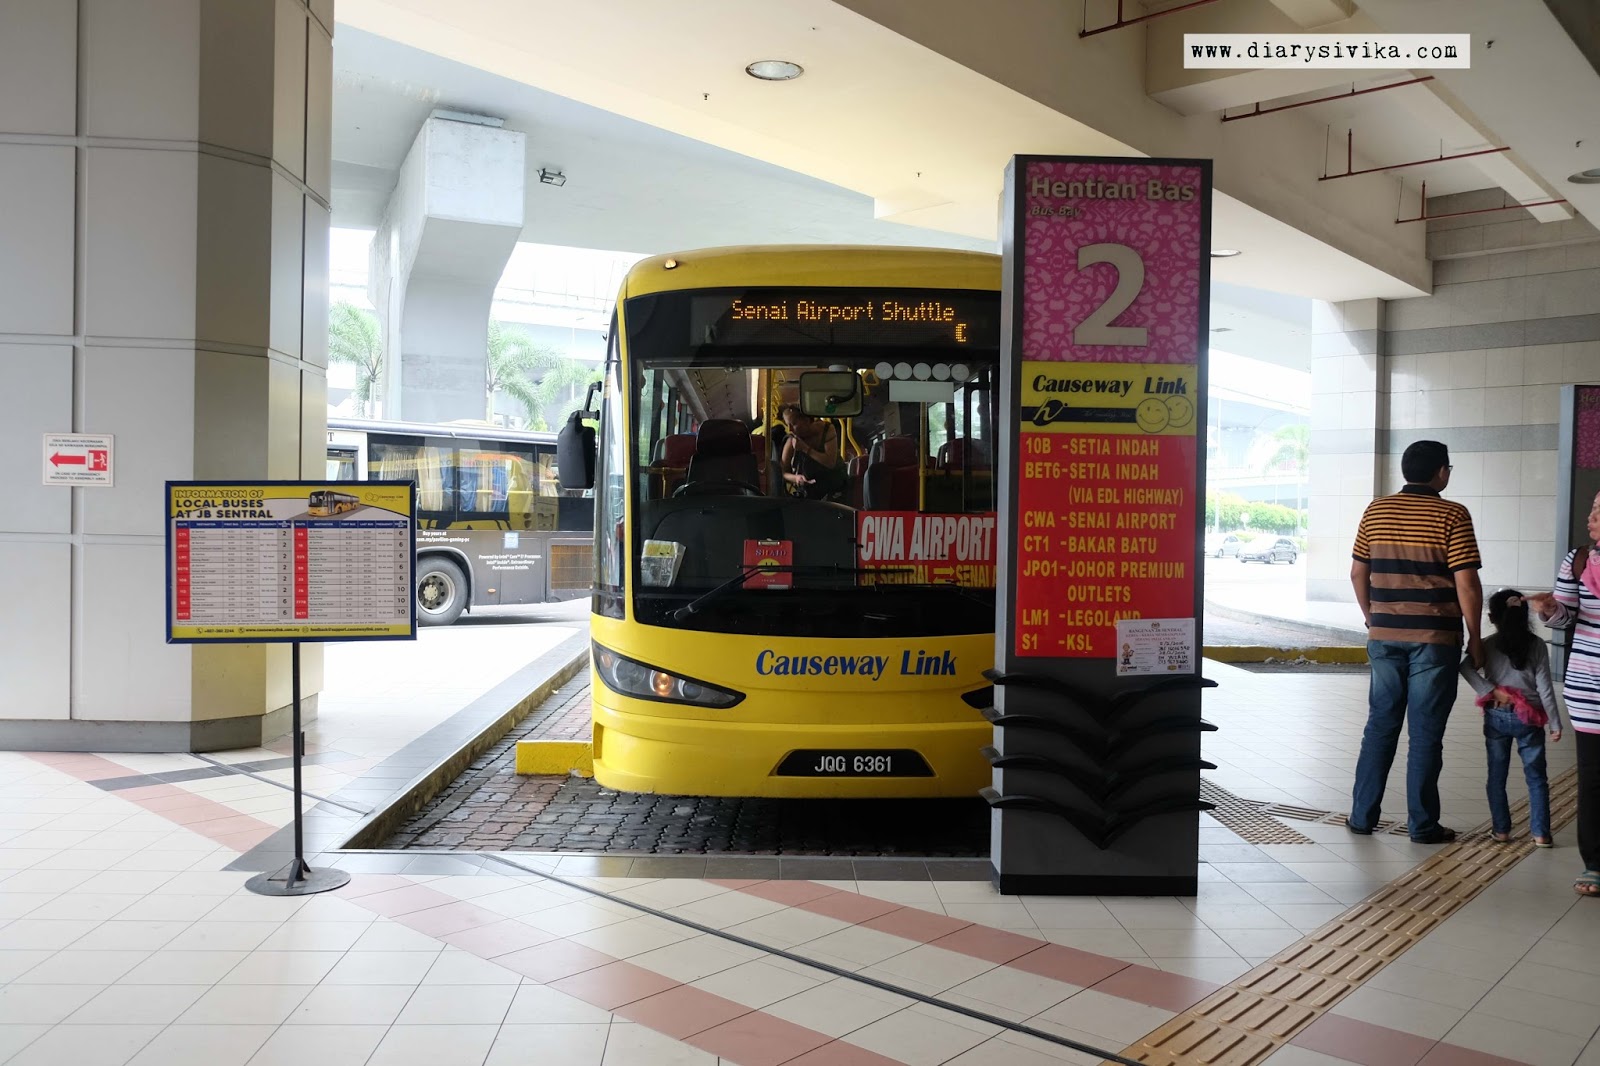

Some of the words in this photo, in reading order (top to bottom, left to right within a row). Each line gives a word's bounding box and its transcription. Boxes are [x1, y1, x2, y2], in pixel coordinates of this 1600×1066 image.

[1030, 176, 1137, 200] Hentian
[1147, 179, 1195, 202] Bas
[1031, 205, 1054, 216] Bus
[1058, 205, 1081, 218] Bay
[1072, 242, 1148, 347] 2
[732, 300, 789, 320] Senai
[797, 301, 875, 323] Airport
[882, 302, 955, 322] Shuttle
[1032, 374, 1134, 397] Causeway
[1144, 376, 1188, 395] Link
[1025, 438, 1051, 455] 10B
[1116, 440, 1159, 456] INDAH
[1115, 463, 1159, 481] INDAH
[175, 490, 247, 498] INFORMATION
[249, 490, 264, 498] OF
[1068, 485, 1094, 504] (VIA
[1097, 487, 1120, 504] EDL
[1124, 487, 1184, 507] HIGHWAY)
[176, 510, 191, 518] AT
[197, 510, 212, 518] JB
[216, 510, 273, 518] SENTRAL
[1024, 511, 1056, 528] CWA
[1116, 512, 1177, 530] AIRPORT
[860, 516, 905, 561] CWA
[909, 516, 995, 561] AIRPORT
[1024, 535, 1050, 553] CT1
[1121, 537, 1157, 554] BATU
[1120, 562, 1185, 579] PREMIUM
[1068, 585, 1131, 603] OUTLETS
[1022, 609, 1049, 626] LM1
[1022, 633, 1038, 650] S1
[755, 650, 889, 681] Causeway
[900, 650, 957, 677] Link
[814, 756, 847, 773] JQG
[853, 755, 892, 773] 6361
